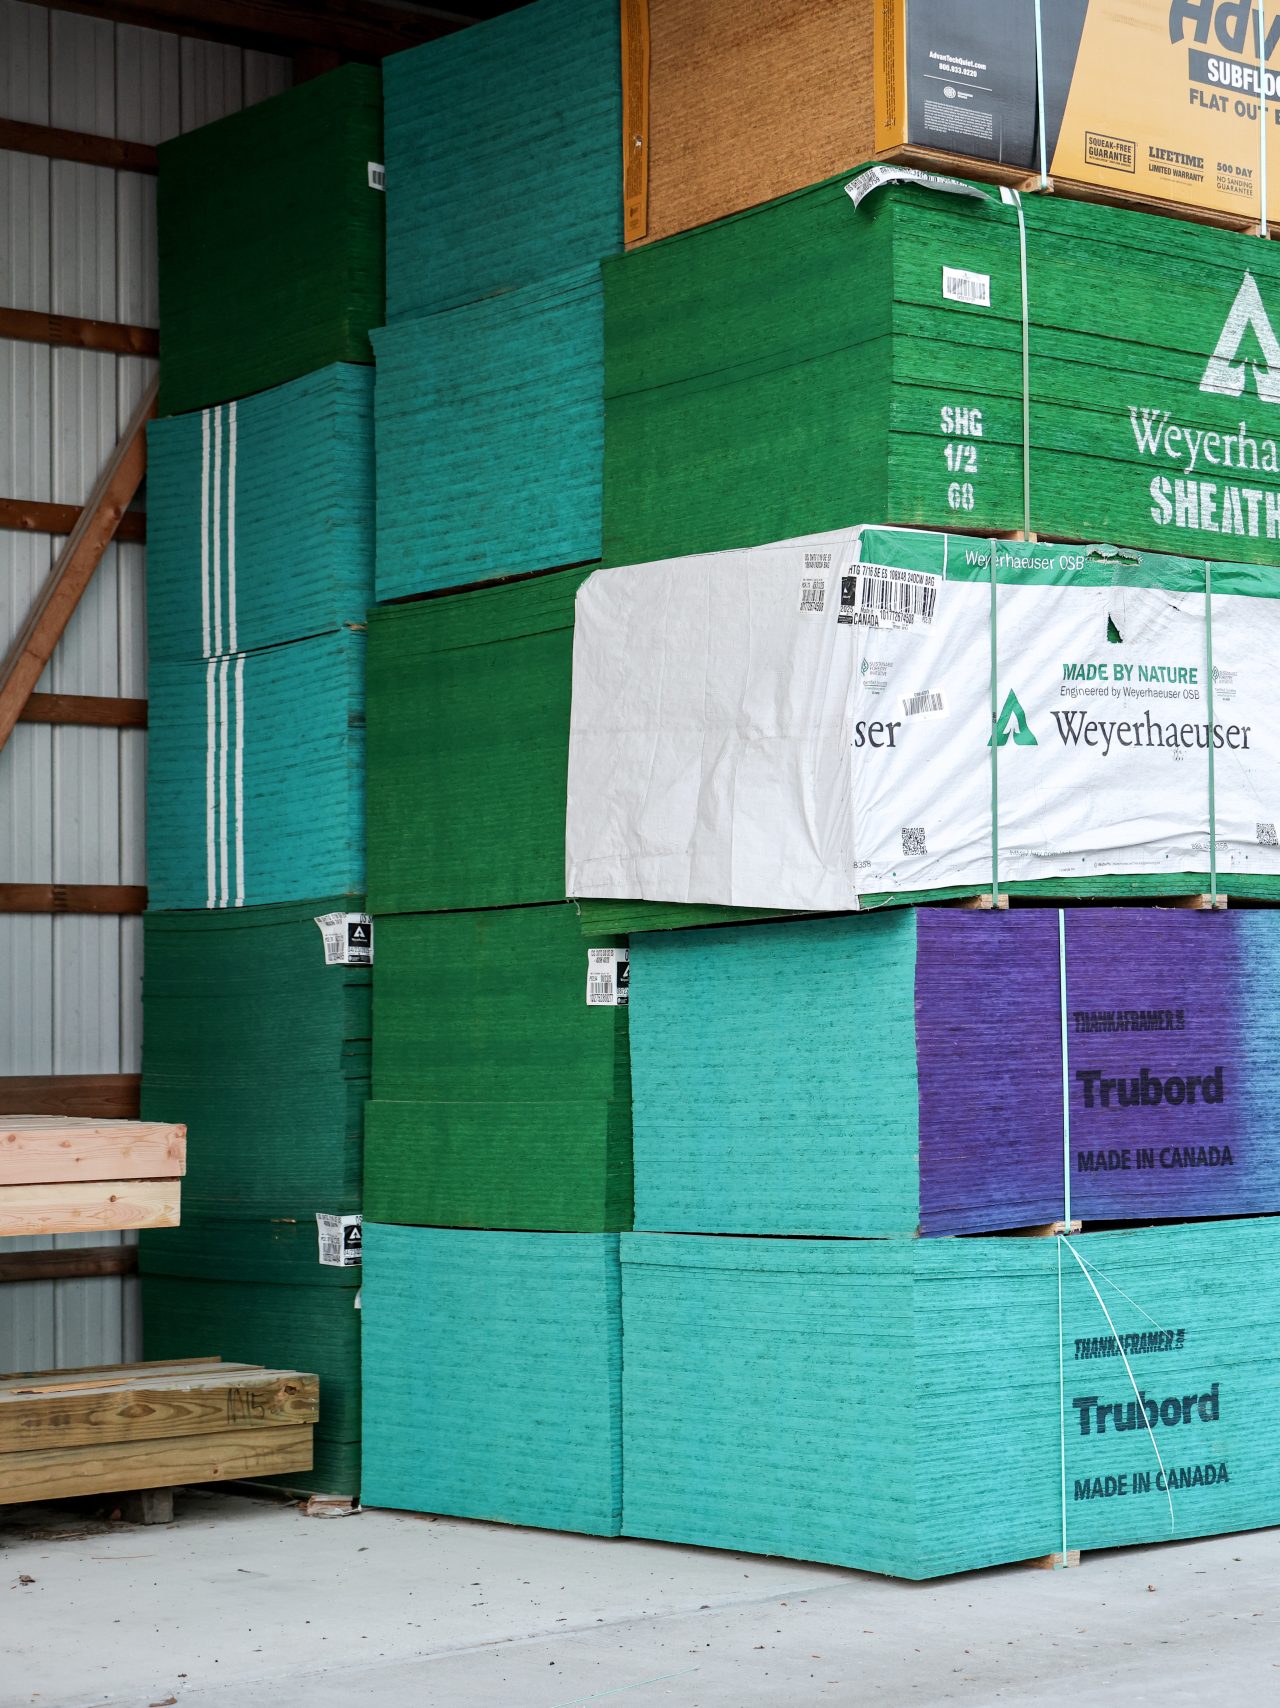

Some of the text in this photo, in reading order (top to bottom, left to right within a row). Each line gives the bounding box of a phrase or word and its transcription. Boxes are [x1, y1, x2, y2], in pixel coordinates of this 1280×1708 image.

[1190, 88, 1229, 112] FLAT
[1088, 137, 1132, 153] SQUEAK-FREE
[1088, 146, 1132, 164] GUARANTEE
[1149, 146, 1204, 168] LIFETIME
[1149, 164, 1204, 182] LIMITED WARRANTY
[1217, 162, 1252, 178] 500 DAY
[1217, 182, 1253, 196] GUARANTEE
[1227, 178, 1252, 188] SANDING
[941, 406, 982, 436] SHG
[944, 444, 977, 472] 1/2
[965, 549, 1084, 570] Weyerhaeuser OSB
[874, 567, 880, 577] SE
[854, 613, 879, 626] CANADA
[1063, 664, 1198, 684] MADE BY NATURE
[1060, 686, 1199, 700] Engineered by Weyerhaeuser OSB
[1050, 710, 1251, 756] Weyerhaeuser
[1076, 1066, 1225, 1108] Trubord
[1077, 1146, 1233, 1172] MADE IN CANADA
[1072, 1383, 1219, 1435] Trubord
[1074, 1463, 1230, 1500] MADE IN CANADA
